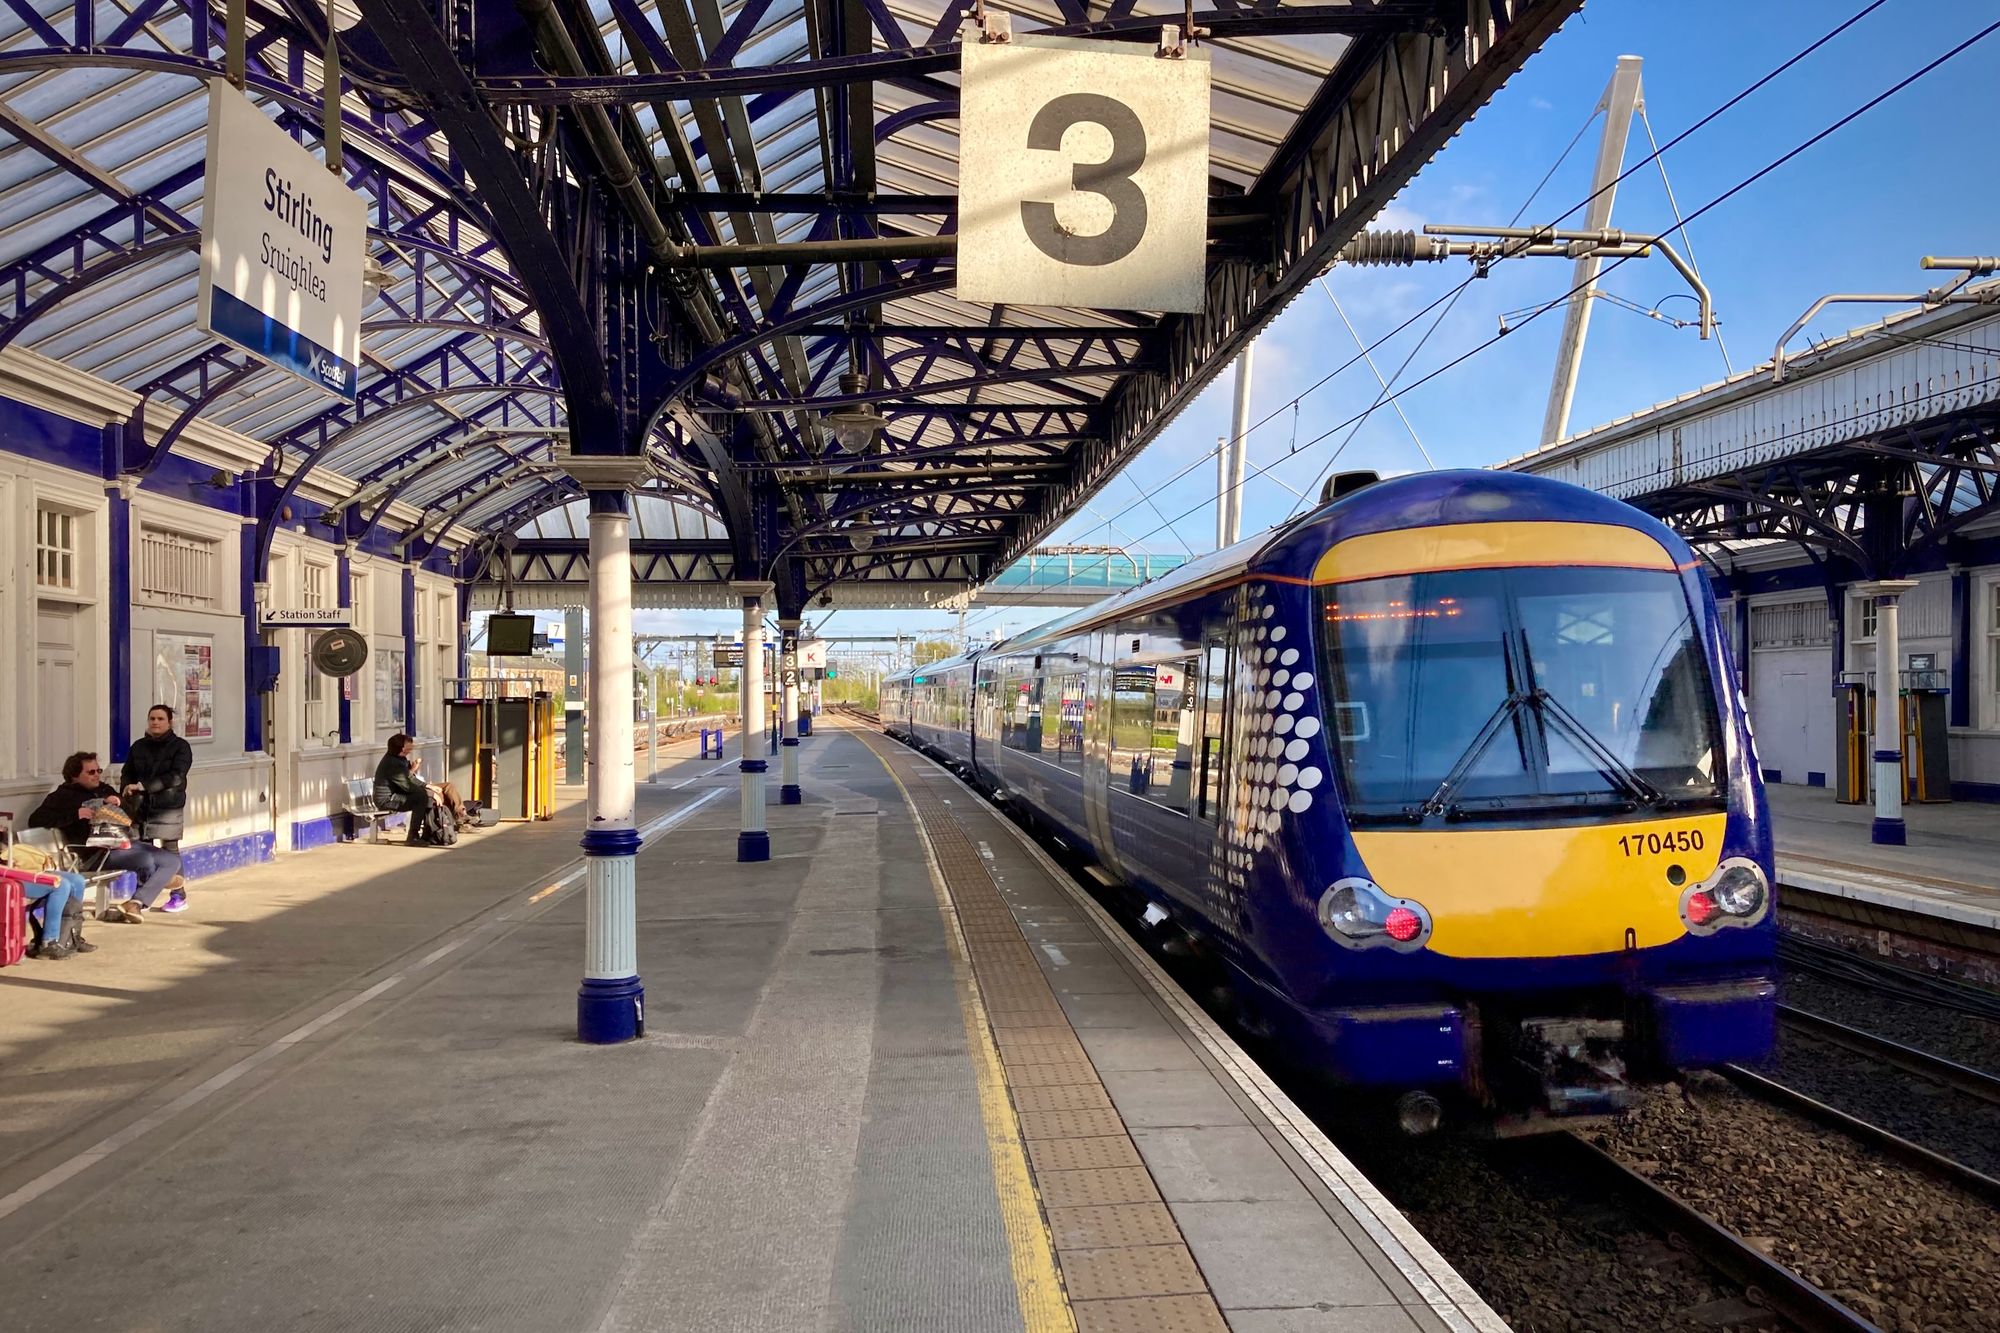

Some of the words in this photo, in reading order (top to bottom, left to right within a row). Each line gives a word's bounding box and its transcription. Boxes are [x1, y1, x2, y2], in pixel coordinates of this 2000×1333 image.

[1020, 92, 1148, 267] 3
[264, 167, 333, 264] Stirling
[260, 232, 326, 303] Sruighlea
[280, 610, 315, 619] Station
[317, 610, 341, 619] Staff
[553, 624, 560, 637] 7
[784, 640, 794, 651] 4
[786, 655, 795, 667] 3
[807, 653, 815, 662] K
[786, 671, 796, 683] 2
[1618, 829, 1704, 857] 170450
